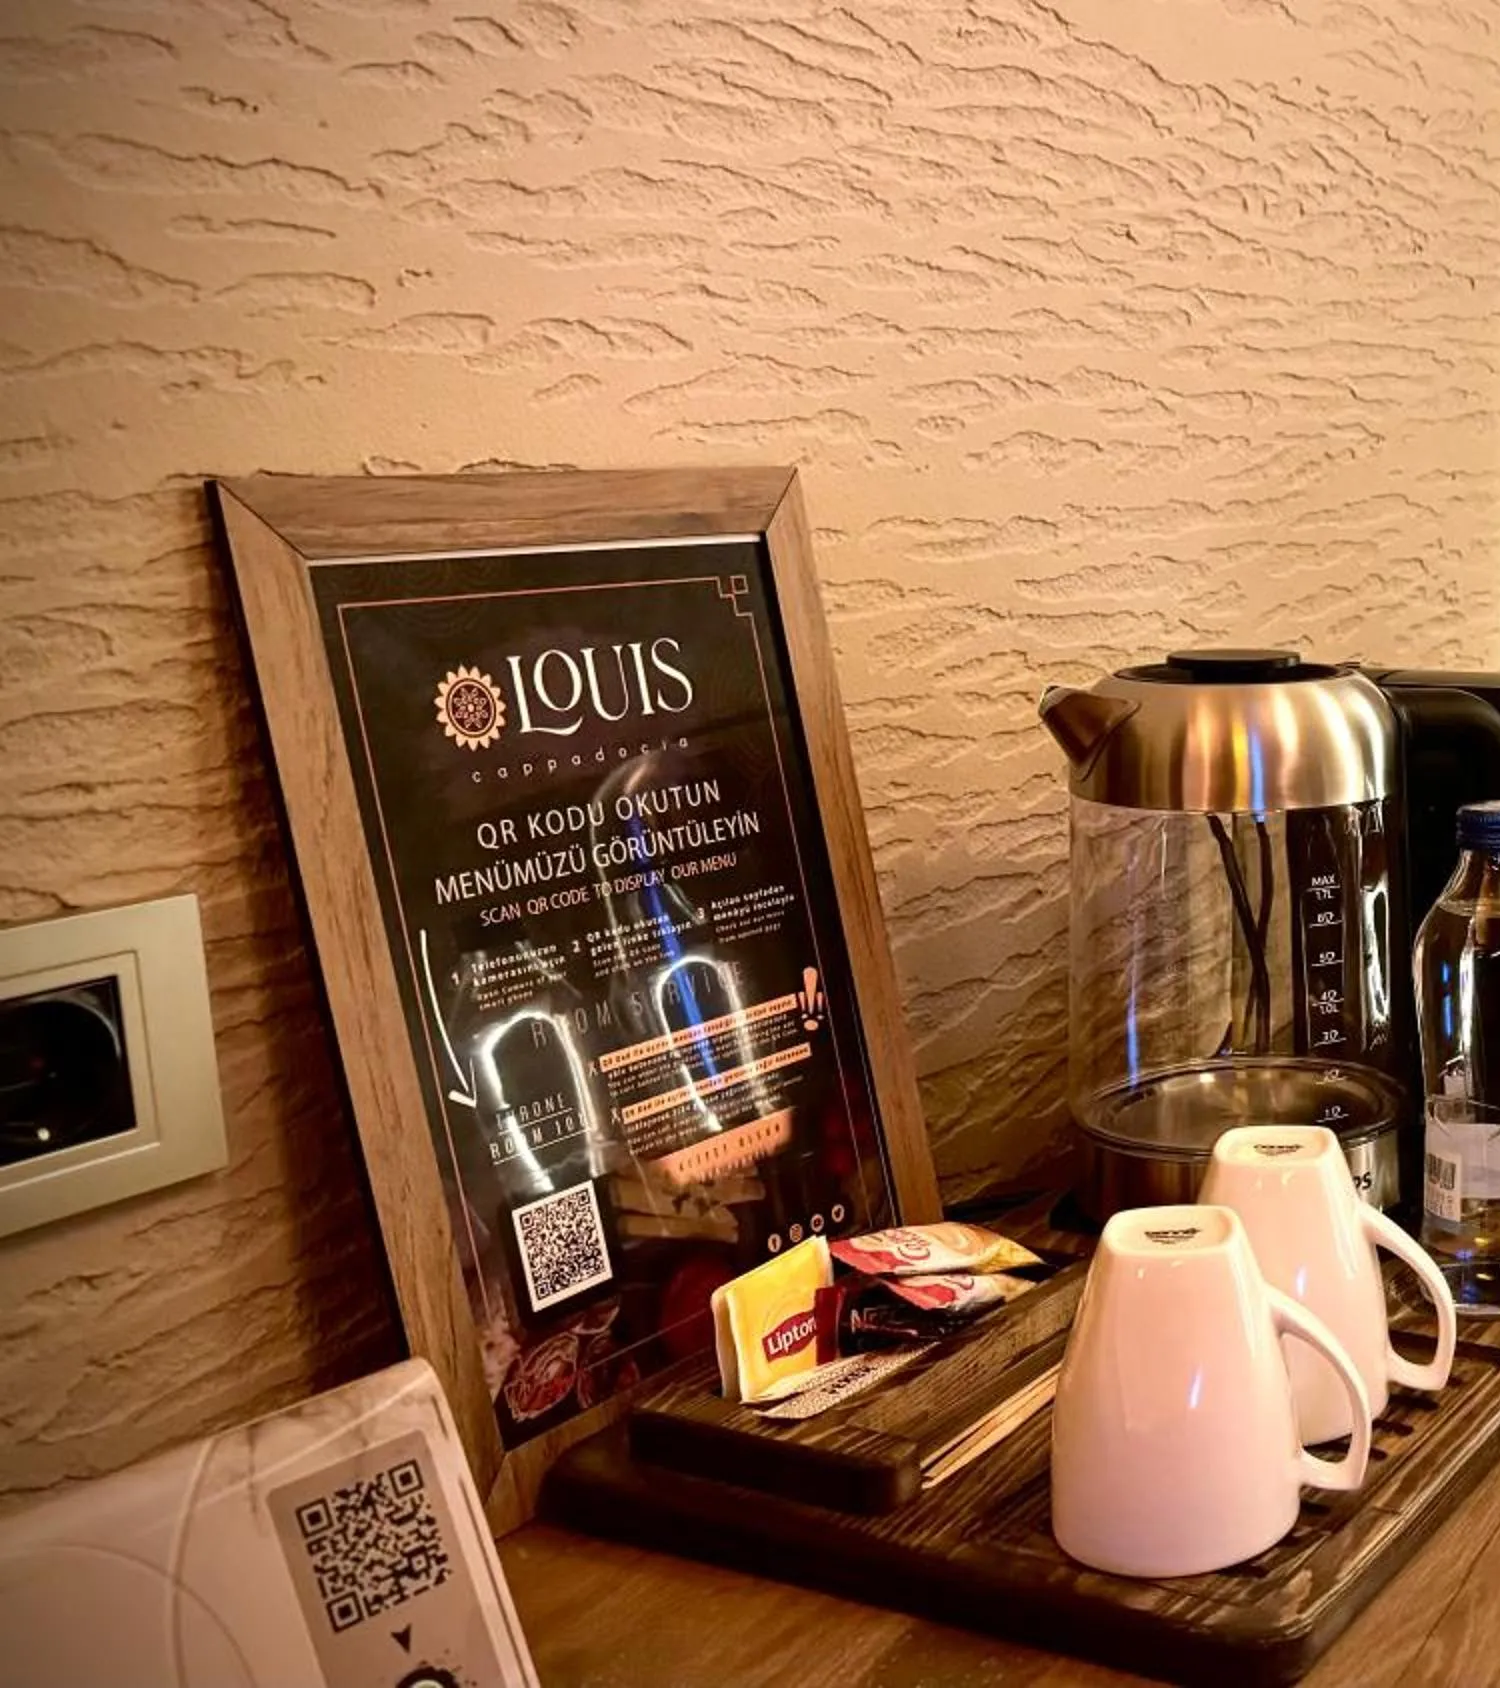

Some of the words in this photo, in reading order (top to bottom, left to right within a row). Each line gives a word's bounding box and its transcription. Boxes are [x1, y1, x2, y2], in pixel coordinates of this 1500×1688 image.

[506, 637, 693, 736] LOUIS
[472, 733, 689, 784] cappadocia
[477, 819, 519, 850] QR
[527, 801, 605, 840] KODU
[616, 779, 721, 821] OKUTUN
[434, 842, 587, 905] MENÜMÜZÜ
[592, 810, 761, 869] GÖRÜNTÜLEYİN
[480, 902, 522, 927] SCAN
[527, 895, 549, 917] QR
[551, 886, 591, 910] CODE
[593, 882, 612, 899] TO
[615, 868, 666, 894] DISPLAY
[671, 858, 701, 880] OUR
[701, 852, 737, 872] MENU
[1311, 874, 1336, 887] MAX
[696, 907, 705, 920] 3
[571, 940, 581, 953] 2
[451, 971, 461, 986] 1
[531, 999, 612, 1048] ROM
[631, 960, 741, 1016] SRVIE
[489, 1127, 543, 1159] ROM
[766, 1316, 817, 1356] Lipton
